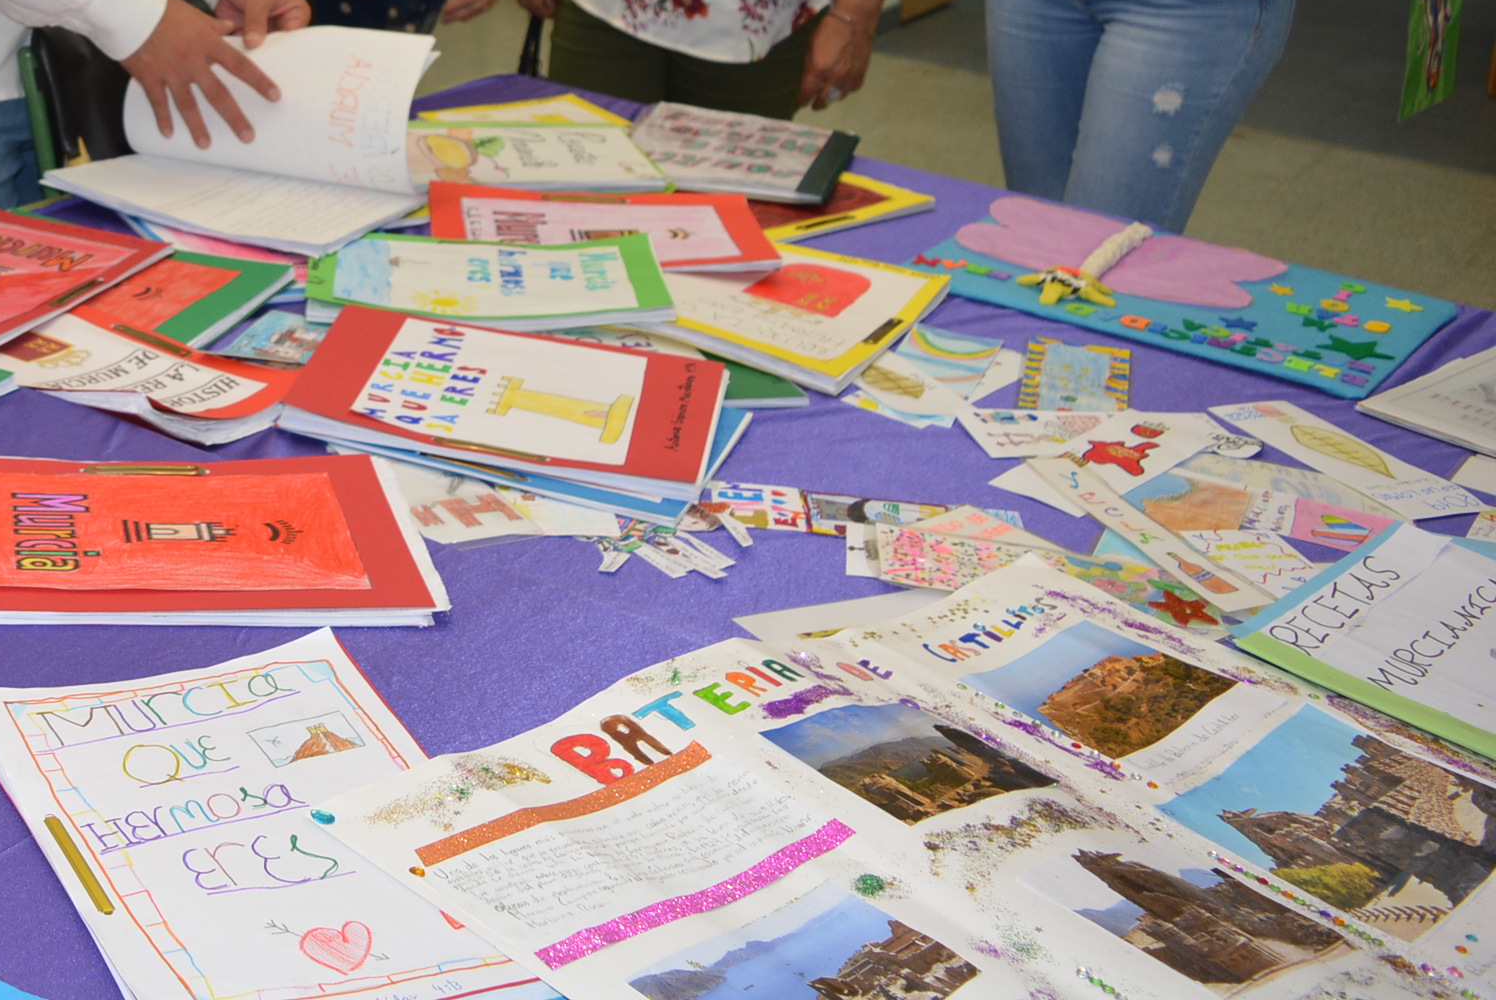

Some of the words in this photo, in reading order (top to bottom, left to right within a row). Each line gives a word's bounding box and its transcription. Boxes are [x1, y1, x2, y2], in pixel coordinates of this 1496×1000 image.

[128, 350, 160, 369] DE
[440, 365, 489, 407] ERES
[12, 491, 101, 573] Murcia
[1269, 555, 1401, 657] RECETAS
[1366, 577, 1496, 693] MURCIANIC
